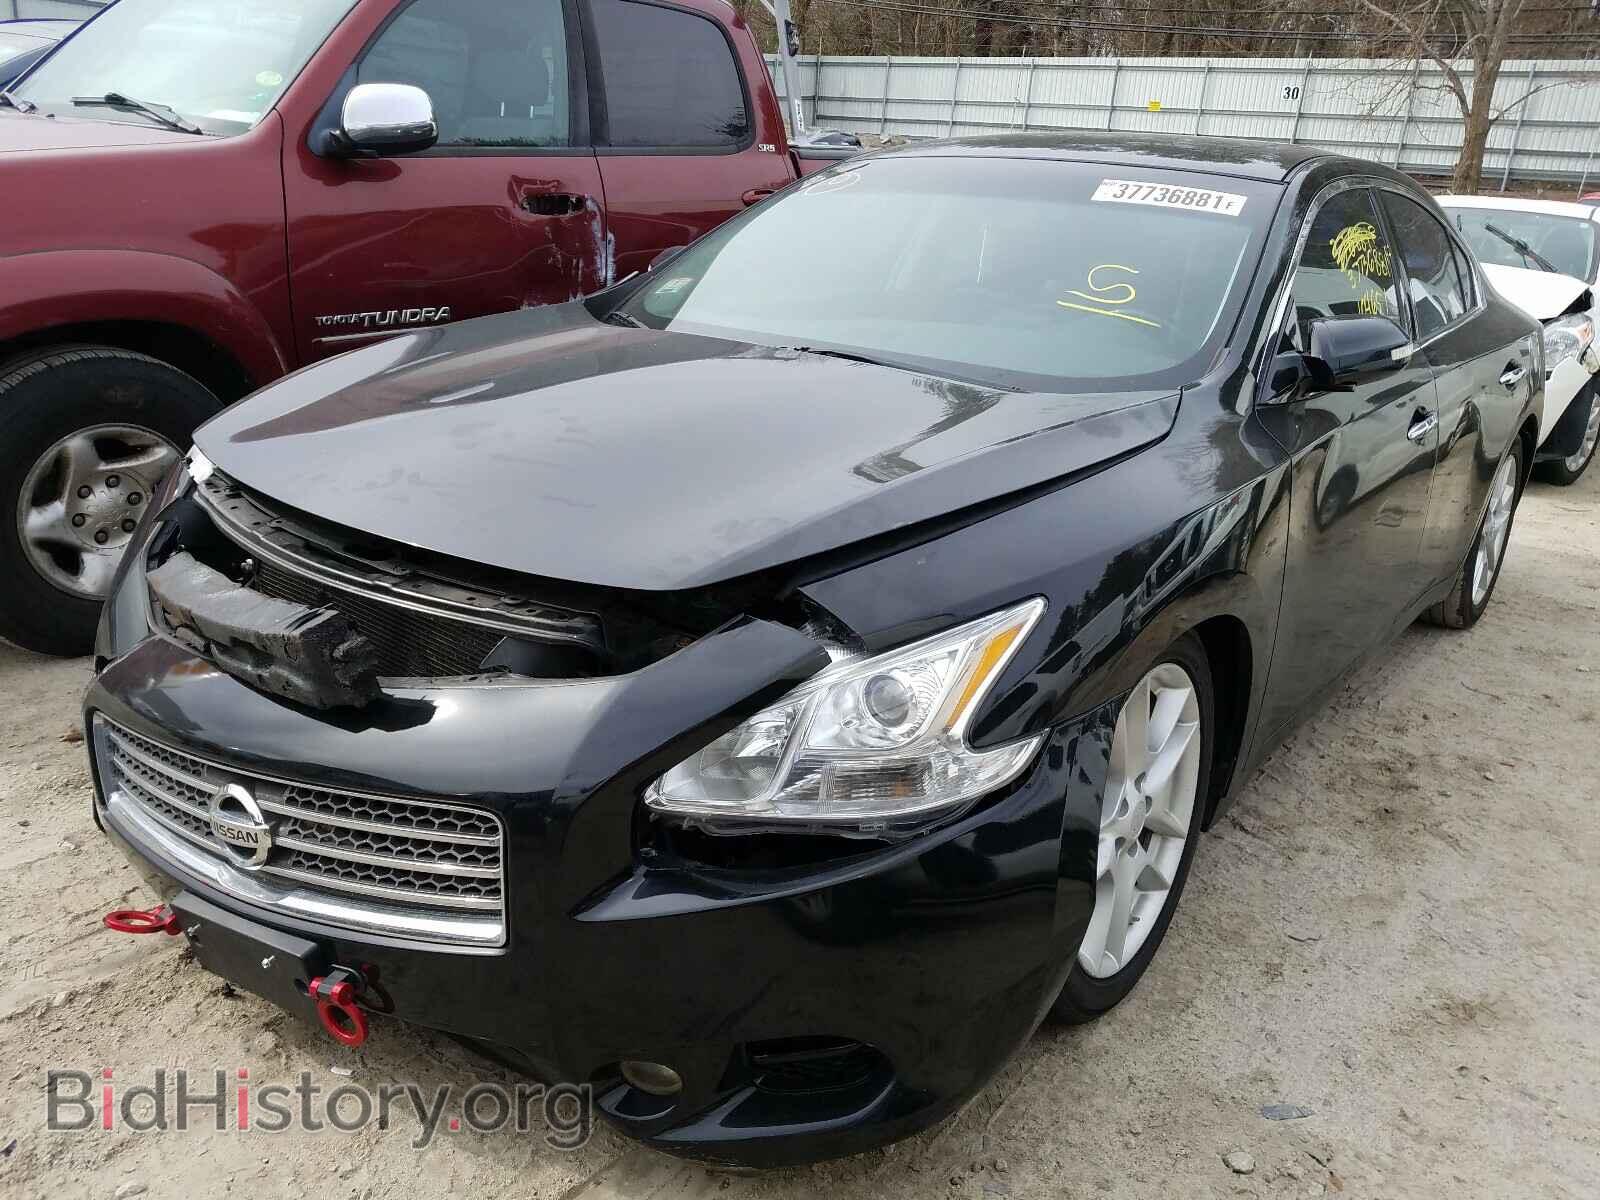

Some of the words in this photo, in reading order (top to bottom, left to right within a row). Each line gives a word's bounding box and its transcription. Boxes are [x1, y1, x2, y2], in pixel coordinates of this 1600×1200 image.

[1282, 86, 1300, 100] 30
[758, 143, 776, 152] SR5
[1112, 182, 1224, 210] 37736881
[313, 313, 360, 327] TOYOTA
[359, 306, 450, 327] TUNDRA
[211, 821, 259, 844] NISSAN
